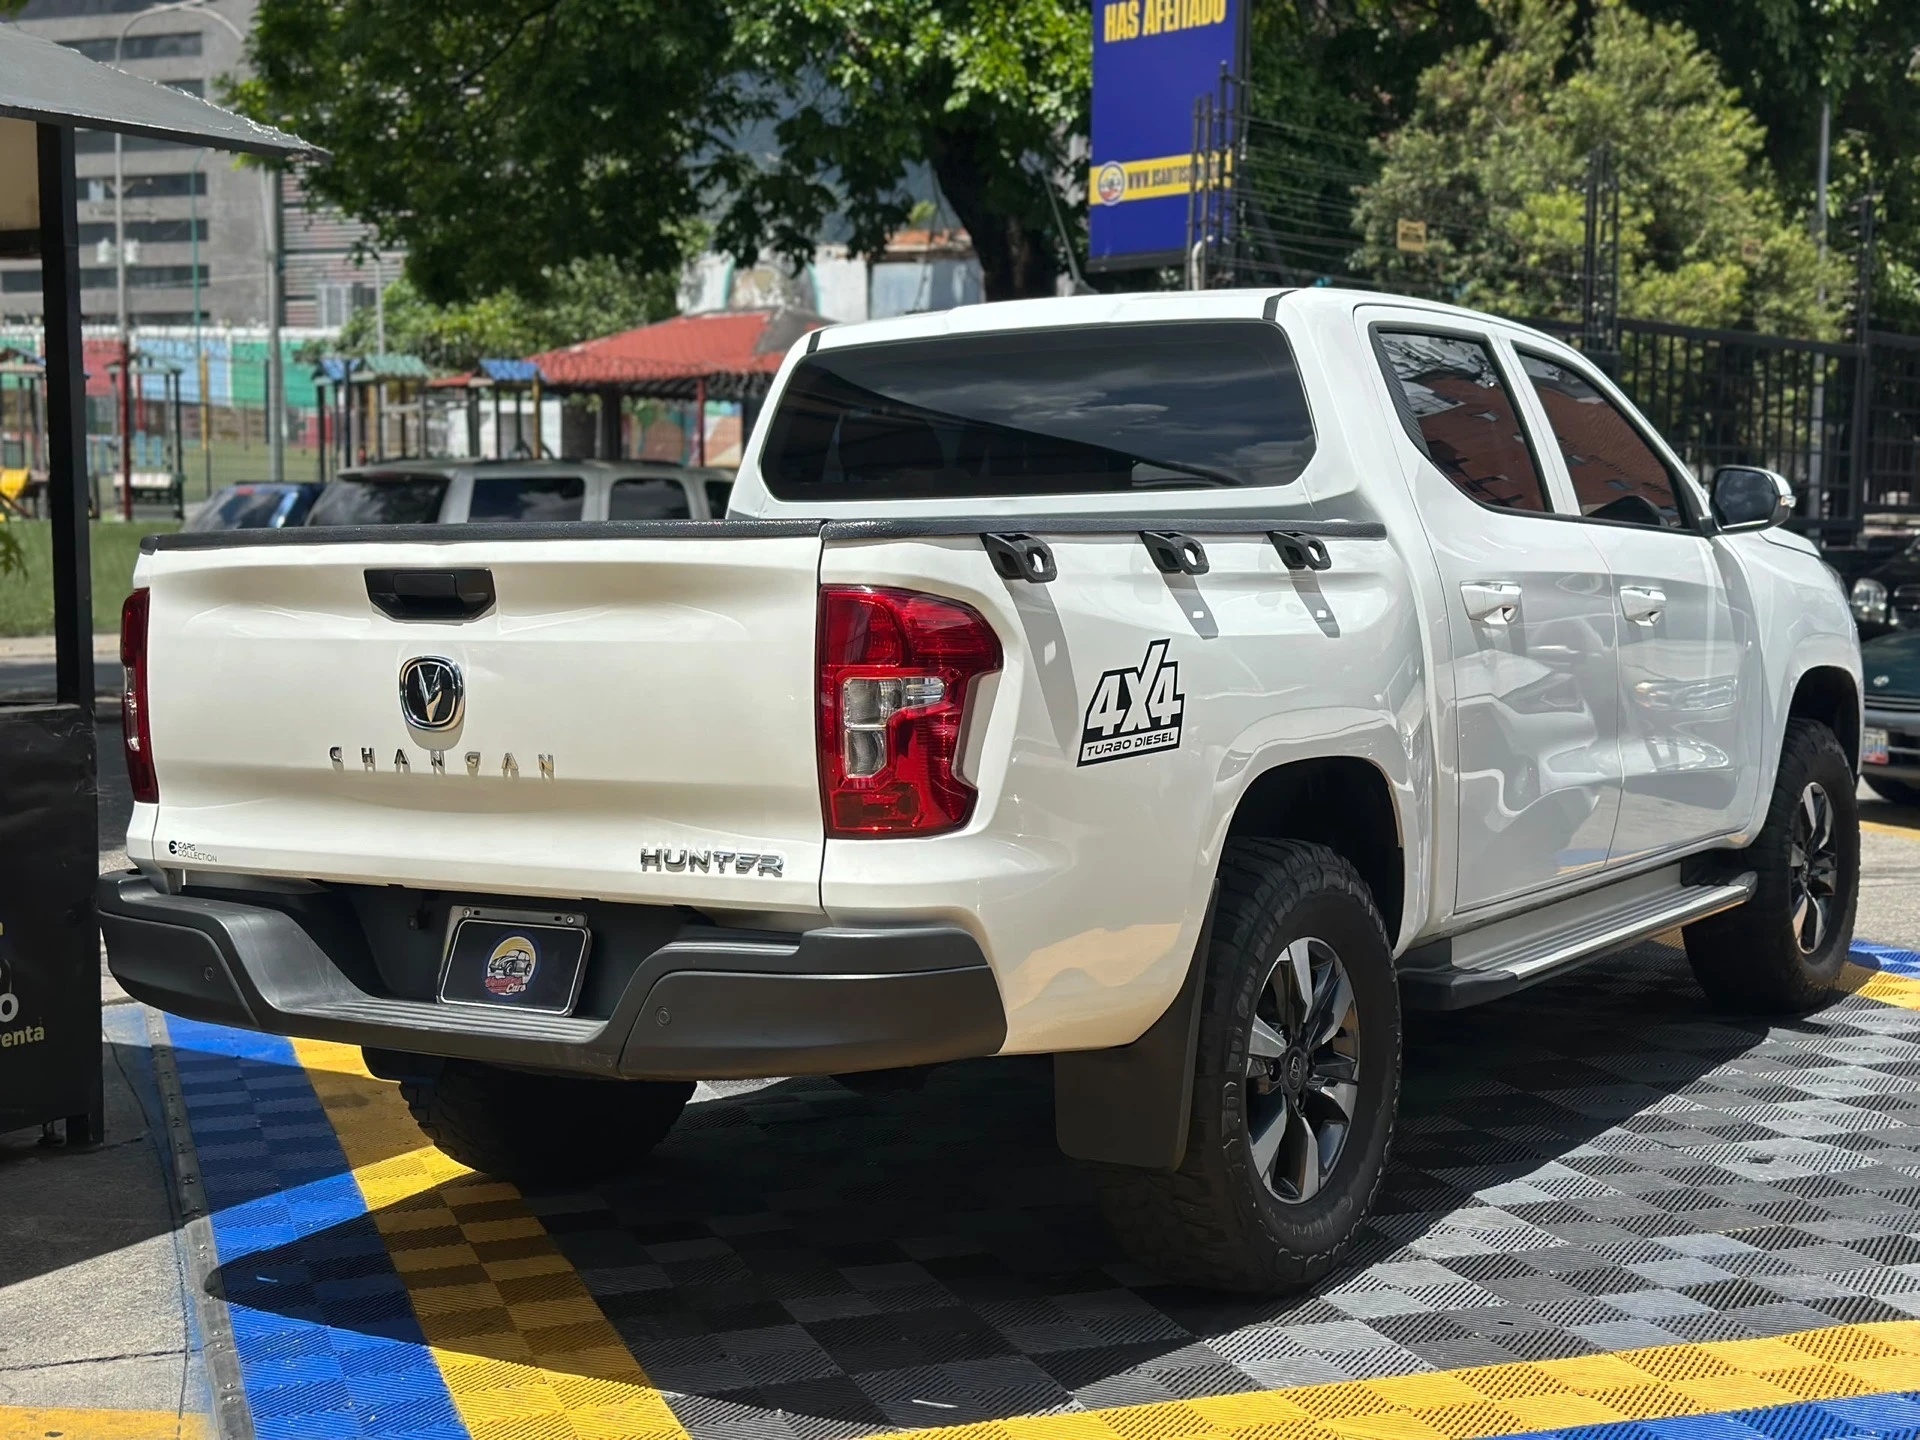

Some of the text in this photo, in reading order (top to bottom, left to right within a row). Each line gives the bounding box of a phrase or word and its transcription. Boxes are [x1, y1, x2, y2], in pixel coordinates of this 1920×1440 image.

[1104, 0, 1227, 43] HAS AFEITADO
[1086, 641, 1182, 737] 4X4
[1087, 732, 1175, 756] TURBO DIESEL
[329, 746, 554, 772] CHANGAN
[178, 850, 218, 862] COLLECTION
[640, 848, 784, 876] HUNTER
[506, 983, 526, 992] Cars
